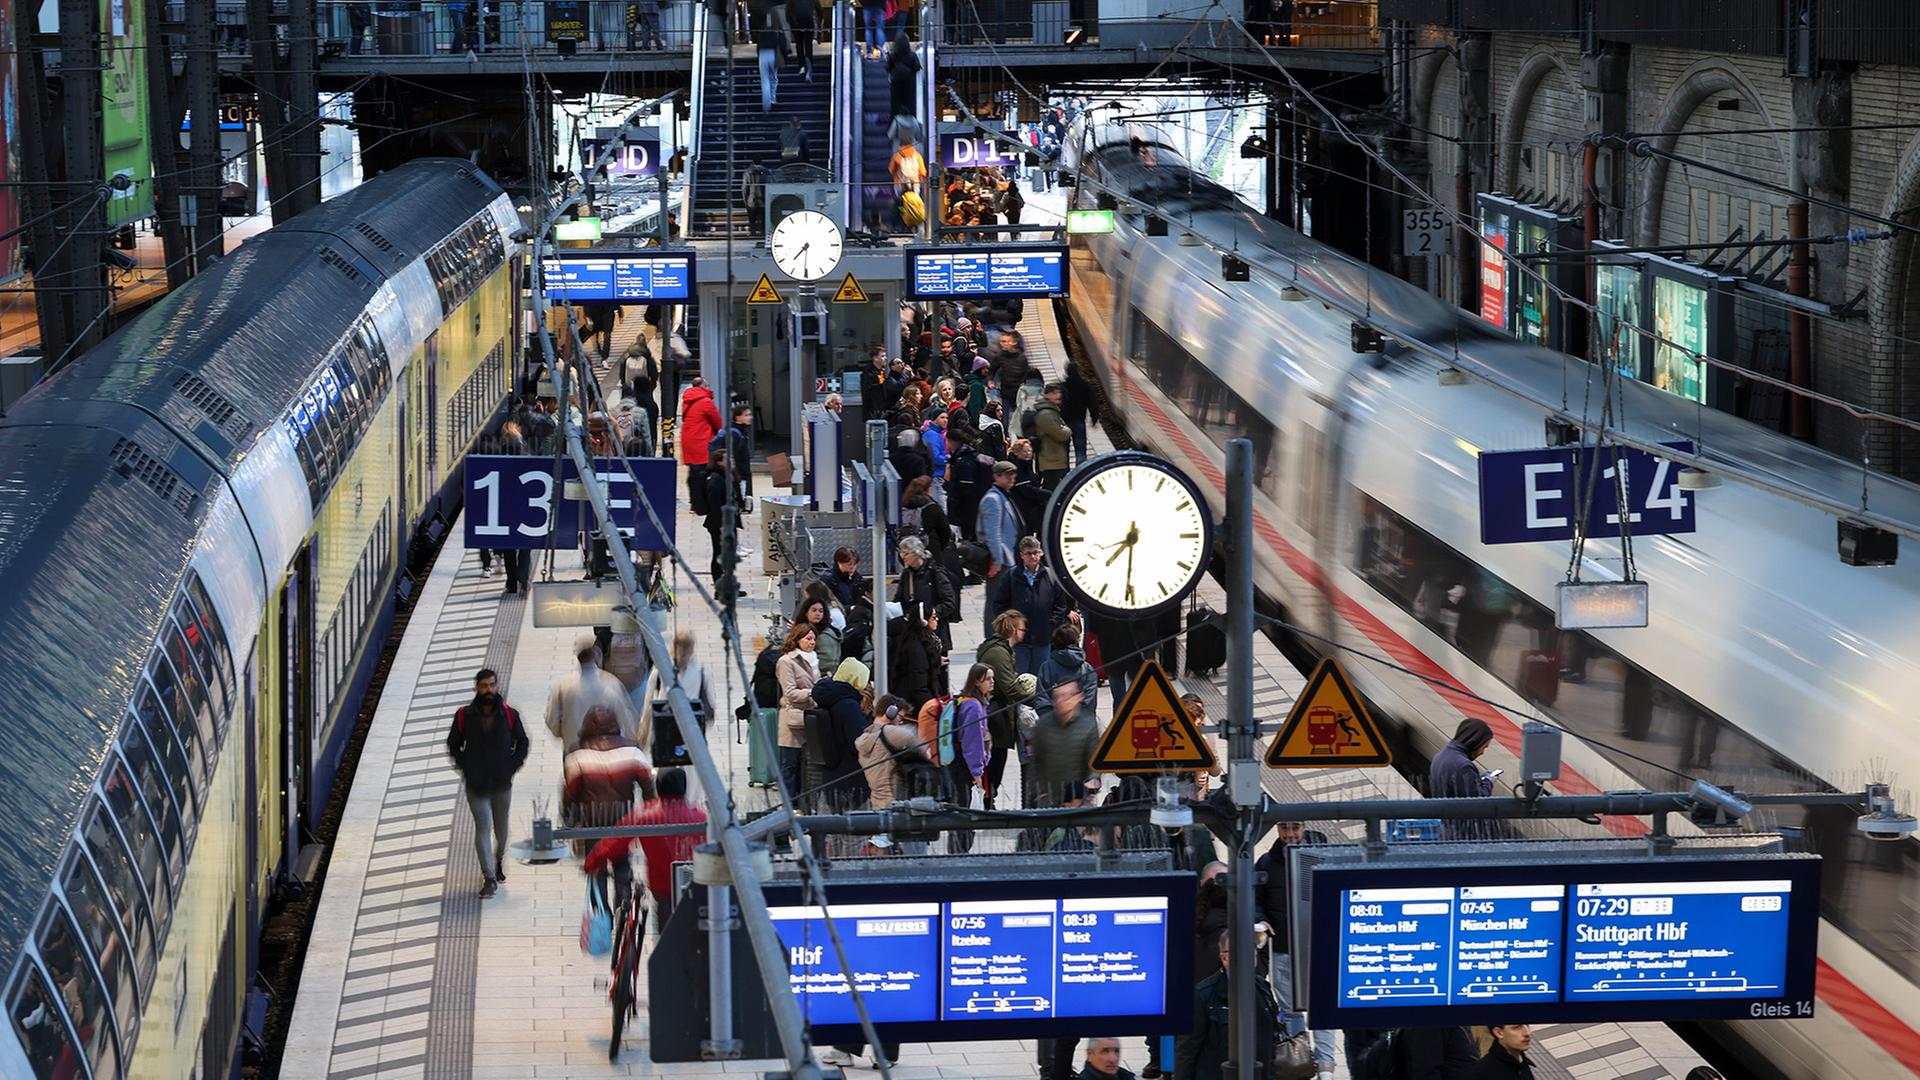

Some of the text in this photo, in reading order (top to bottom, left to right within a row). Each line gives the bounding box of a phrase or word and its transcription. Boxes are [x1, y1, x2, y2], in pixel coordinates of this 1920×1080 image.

[628, 145, 648, 170] D
[953, 138, 974, 163] D
[1406, 211, 1444, 230] 355
[1419, 232, 1432, 251] 2
[1524, 456, 1688, 529] E 14
[473, 471, 636, 537] 13 E
[1350, 905, 1383, 917] 08:01
[1461, 902, 1494, 914] 07:45
[1577, 898, 1629, 916] 07:29
[951, 917, 986, 929] 07:56
[1063, 914, 1097, 926] 08:18
[1350, 920, 1418, 934] München Hbf
[1461, 917, 1528, 931] München Hbf
[951, 934, 991, 946] Itzehoe
[1063, 931, 1091, 943] Wrist
[1576, 922, 1688, 946] Stuttgart Hbf
[791, 945, 823, 965] Hbf
[1750, 1001, 1812, 1017] Gleis 14
